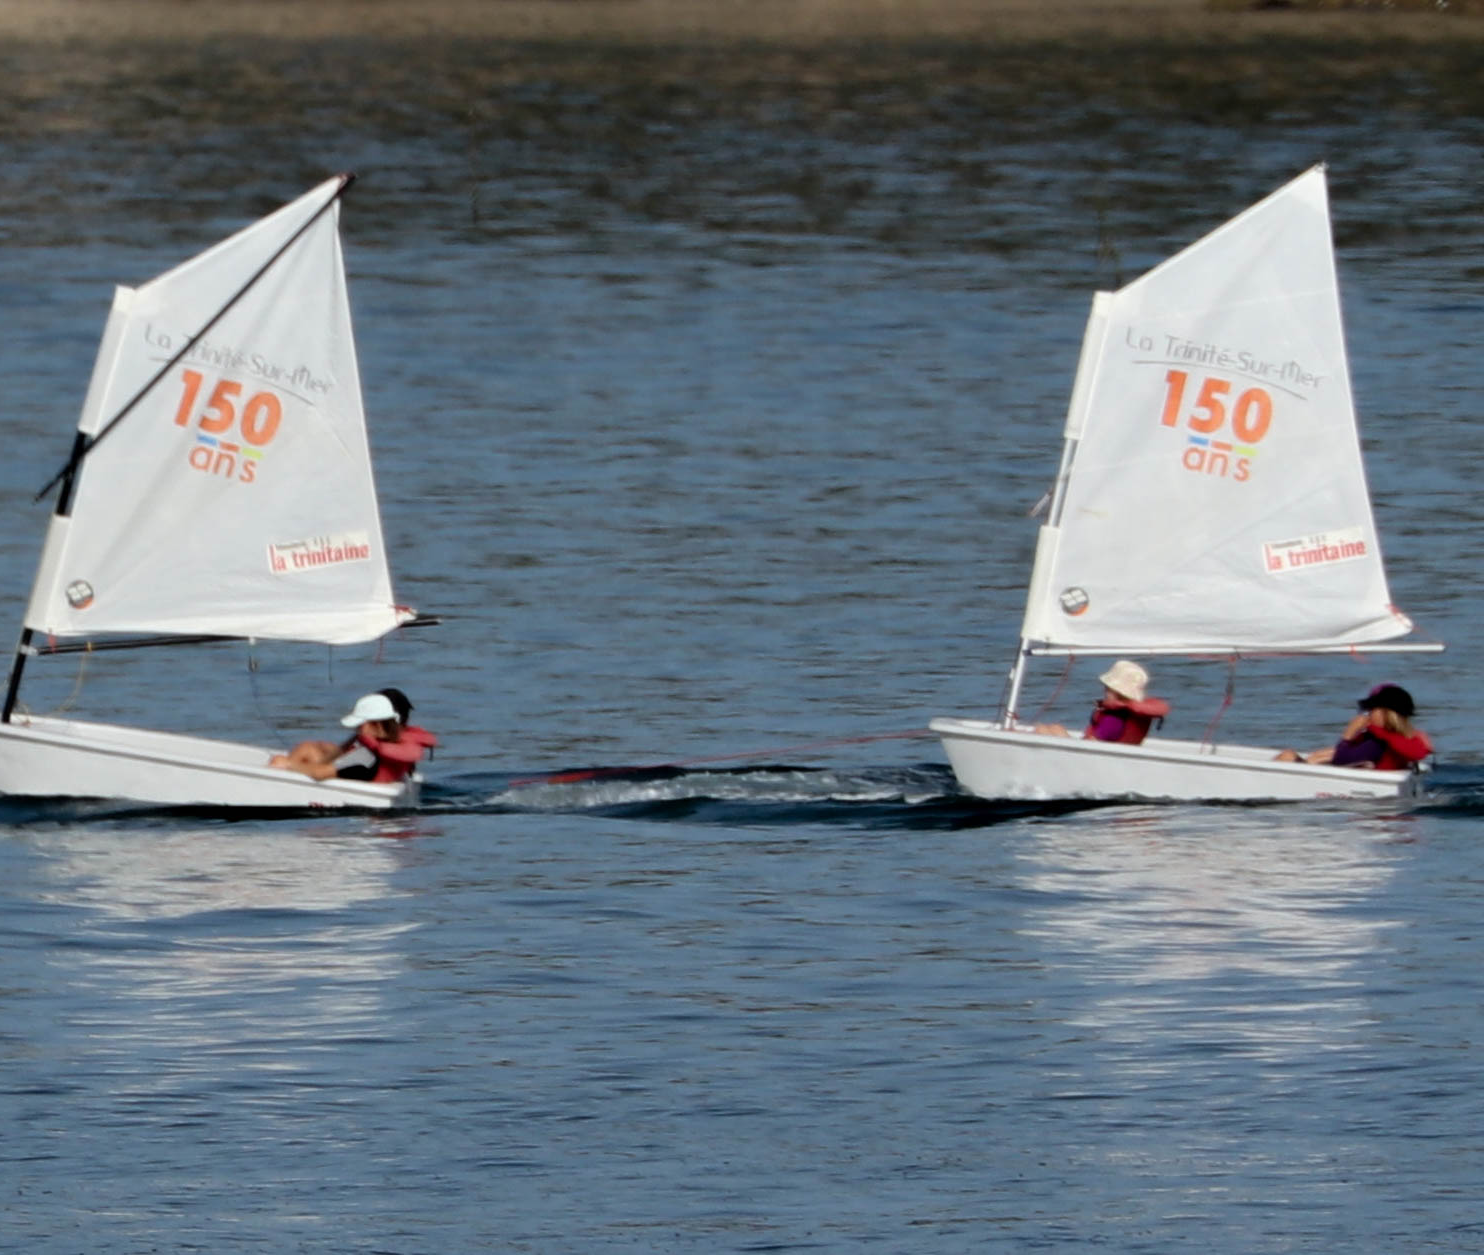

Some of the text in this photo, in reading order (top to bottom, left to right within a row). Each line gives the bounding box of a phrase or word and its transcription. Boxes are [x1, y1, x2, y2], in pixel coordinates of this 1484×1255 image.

[143, 323, 171, 350] La
[1124, 326, 1325, 390] La Trinité-Sur-Mer
[174, 368, 283, 446] 150
[1161, 369, 1273, 445] 150
[188, 446, 257, 484] ans
[1182, 446, 1252, 483] ans
[268, 543, 287, 572] la
[291, 541, 371, 568] trinitaine
[1264, 543, 1283, 572] la
[1287, 539, 1367, 567] trinitaine
